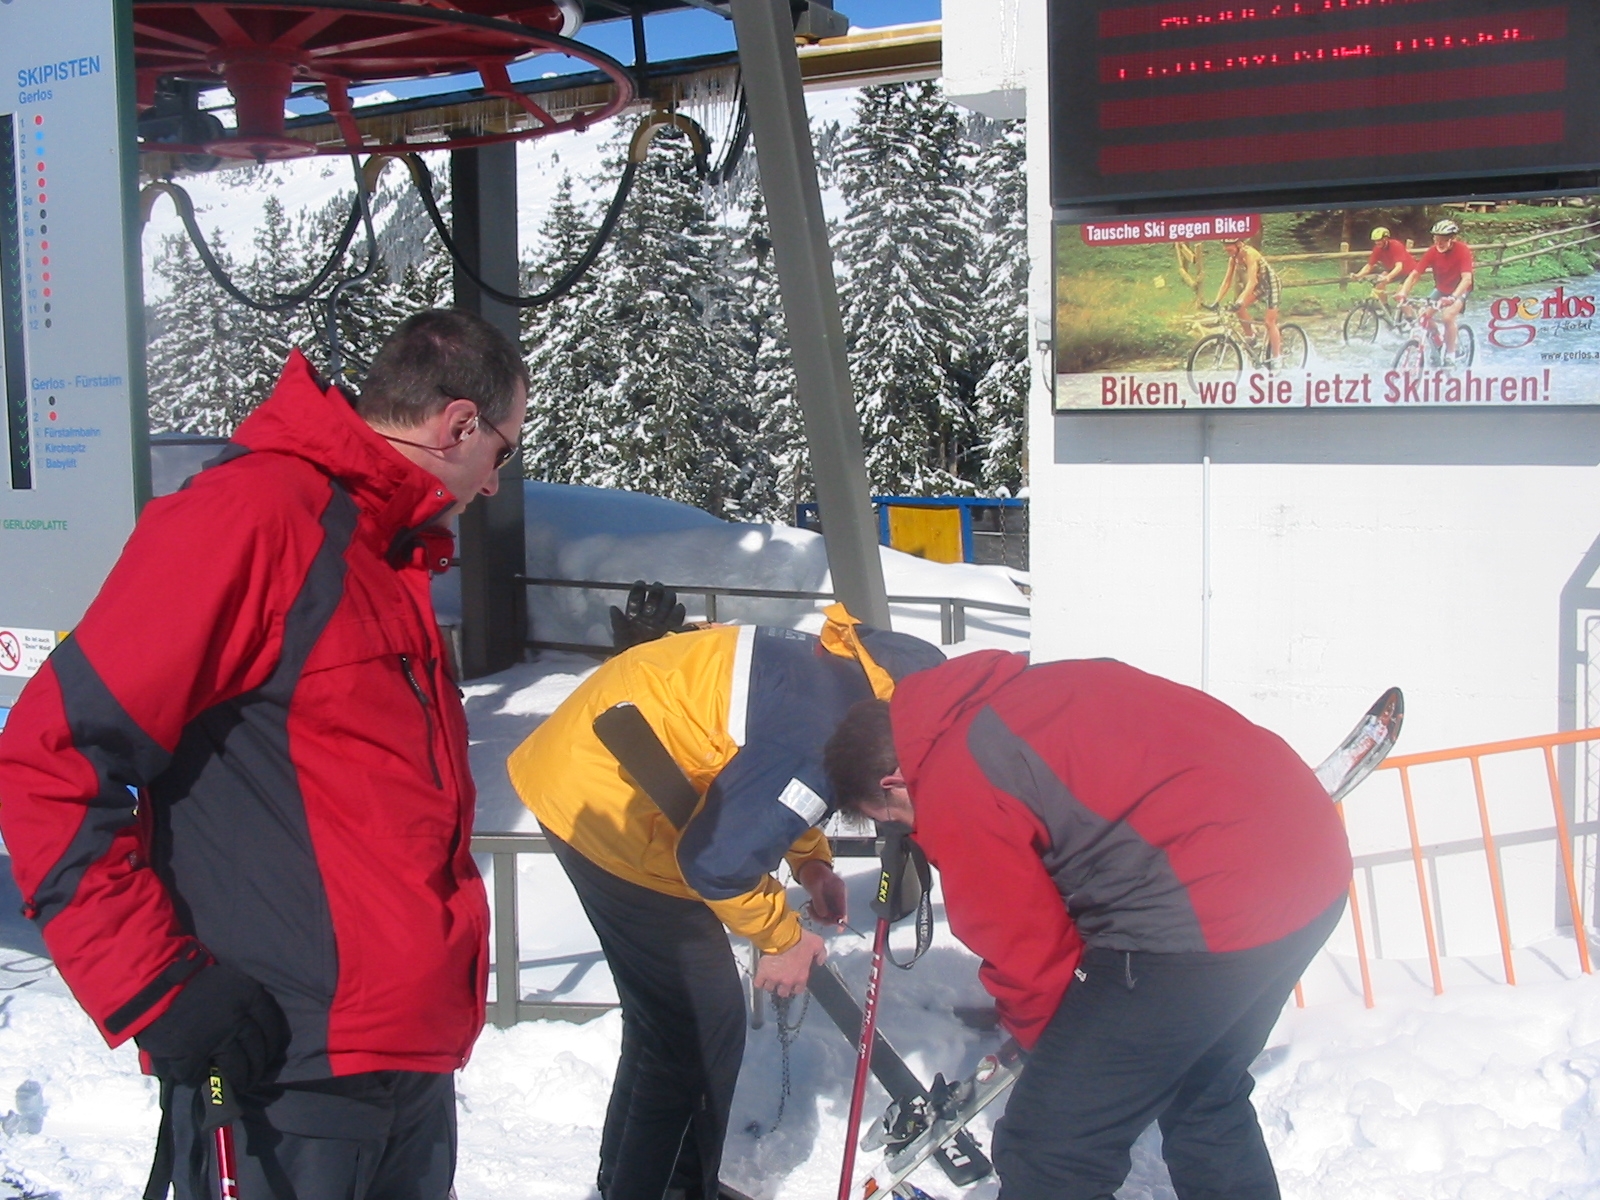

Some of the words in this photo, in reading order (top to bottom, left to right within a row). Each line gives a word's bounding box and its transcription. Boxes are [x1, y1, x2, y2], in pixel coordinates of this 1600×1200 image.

[17, 55, 100, 88] SKIPISTEN
[19, 89, 53, 104] Gerlos
[21, 134, 26, 144] 2
[1087, 225, 1140, 241] Tausche
[1144, 221, 1165, 238] Ski
[1169, 222, 1210, 239] gegen
[1215, 216, 1250, 234] Bike!
[1488, 286, 1596, 349] gerlos
[32, 377, 65, 390] Gerlos
[75, 374, 122, 388] Fürstalm
[1101, 376, 1187, 408] Biken,
[1200, 381, 1237, 405] wo
[1249, 373, 1292, 404] Sie
[1305, 373, 1371, 407] jetzt
[1384, 368, 1550, 403] Skifahren!
[33, 412, 39, 422] 2
[3, 519, 68, 530] GERLOSPLATTE
[880, 871, 891, 903] LEKI
